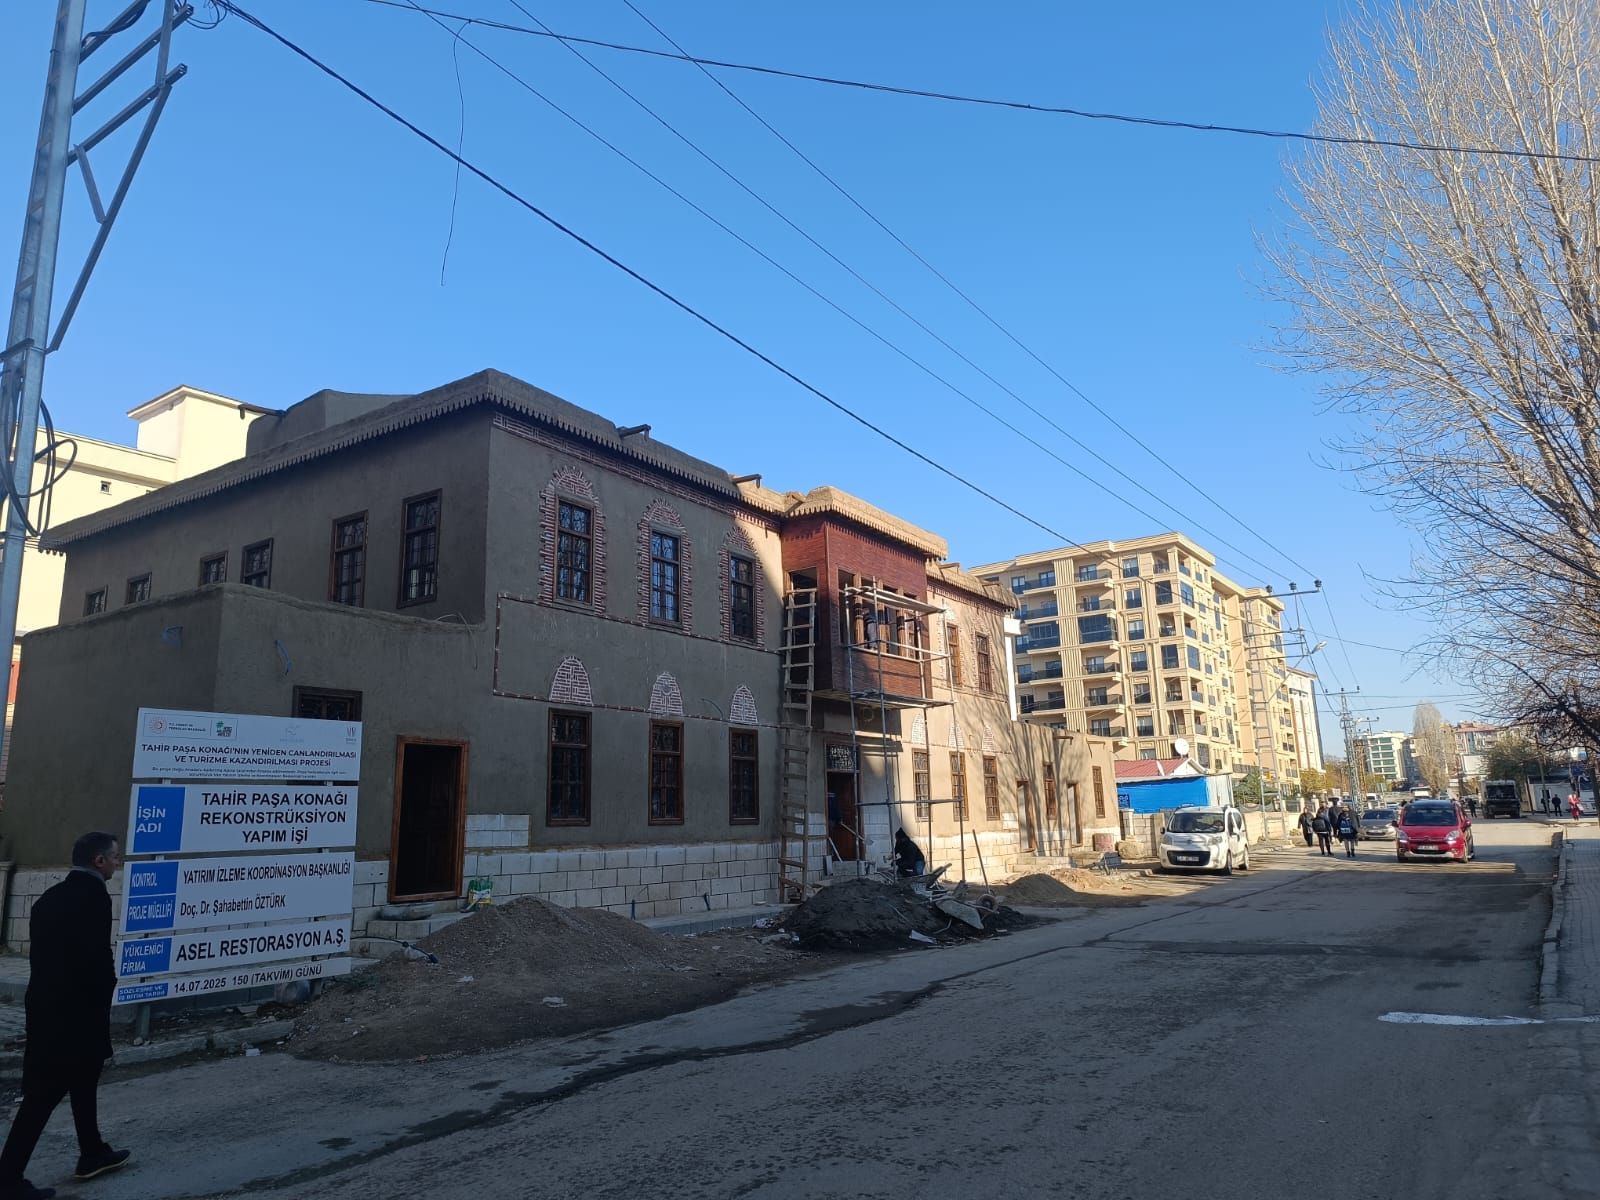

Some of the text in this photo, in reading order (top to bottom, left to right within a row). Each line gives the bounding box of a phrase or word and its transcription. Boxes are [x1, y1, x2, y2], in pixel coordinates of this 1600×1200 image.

[142, 742, 170, 752] TAHİR
[172, 744, 196, 754] PAŞA
[252, 747, 286, 756] YENİDEN
[289, 750, 356, 758] CANLANDIRILMASI
[190, 755, 228, 763] TURİZME
[230, 757, 298, 766] KAZANDIRILMASI
[300, 758, 331, 766] PROJESİ
[202, 790, 348, 808] TAHİR PAŞA KONAĞI
[138, 806, 166, 820] İŞİN
[200, 809, 346, 824] REKONSTRÜKSİYON
[136, 822, 162, 833] ADI
[242, 827, 308, 844] YAPIM İŞİ
[184, 859, 350, 884] YATIRIM İZLEME KOORDİNASYON BAŞKANLIĞI
[132, 872, 158, 888] KONTROL
[128, 905, 148, 920] PROJE
[180, 892, 286, 918] Doç. Dr. Şahabettin ÖZTÜRK
[124, 942, 164, 957] YÜKLENİCİ
[176, 928, 346, 962] ASEL RESTORASYON A.Ş.
[122, 961, 146, 974] FİRMA
[174, 964, 322, 994] 14.07.2025 150 (TAKVİM) GÜNÜ
